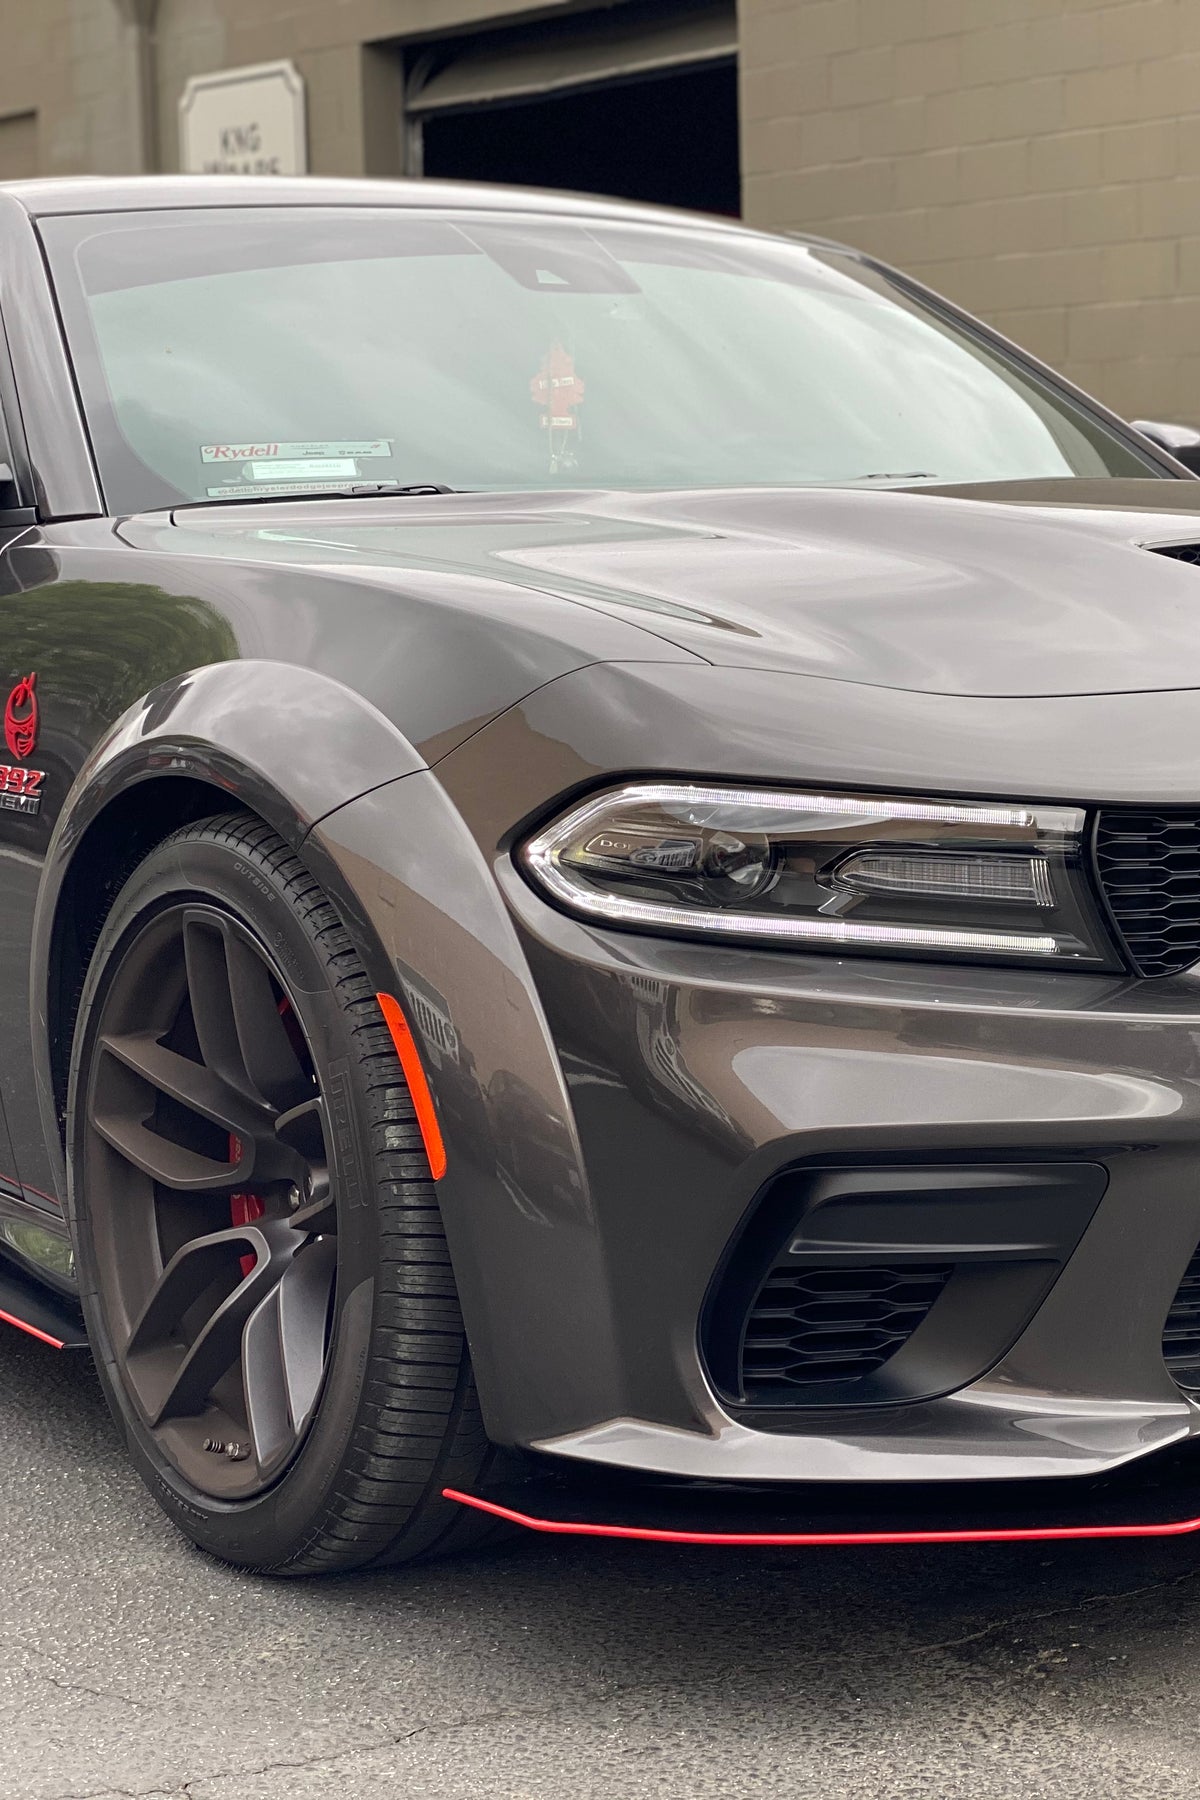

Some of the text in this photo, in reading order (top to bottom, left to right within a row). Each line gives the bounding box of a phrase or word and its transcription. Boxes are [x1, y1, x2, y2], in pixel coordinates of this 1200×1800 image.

[204, 444, 279, 460] Rydell
[0, 795, 39, 815] EMI
[233, 862, 277, 902] OUTSIDE
